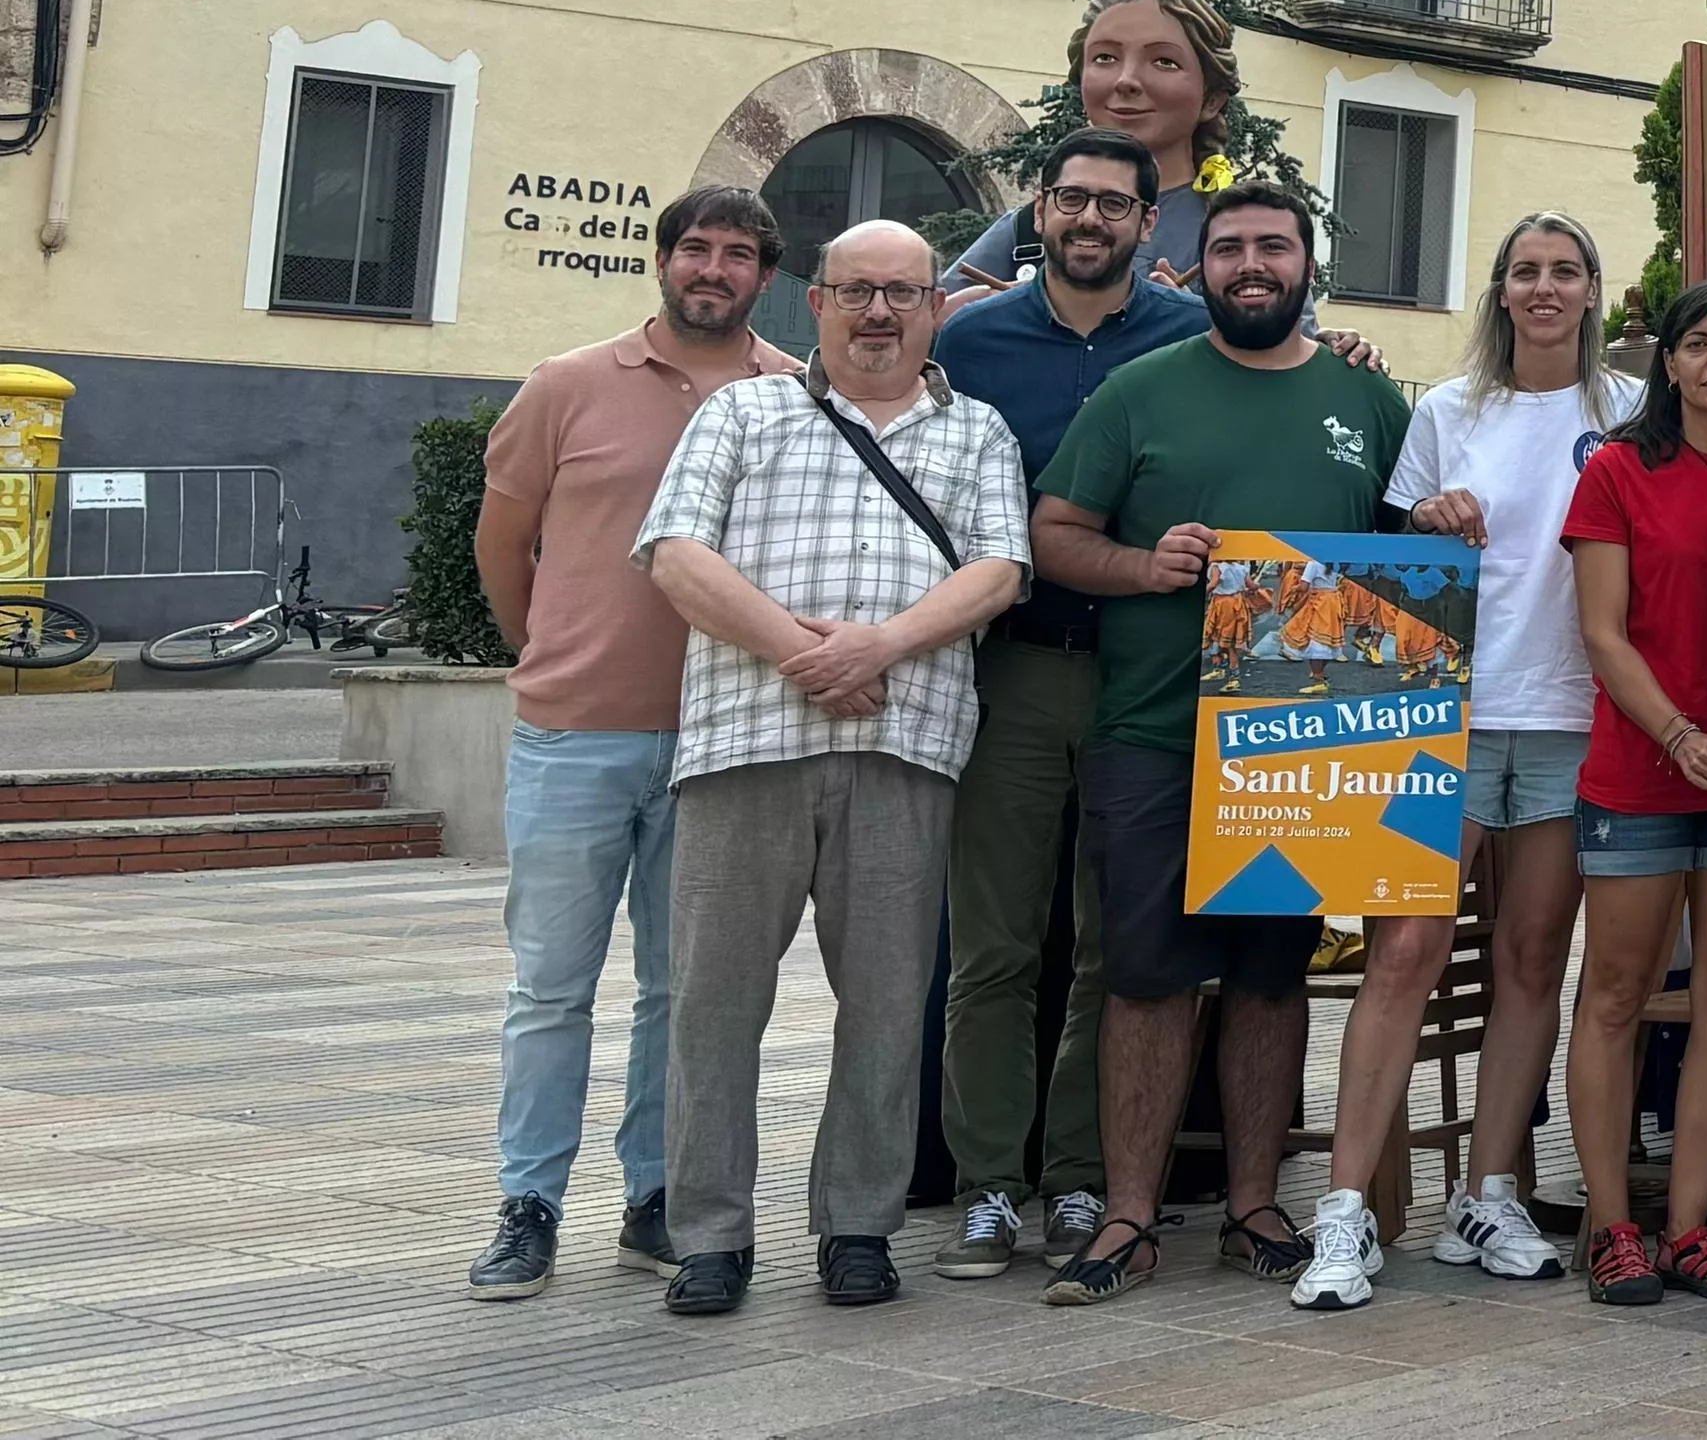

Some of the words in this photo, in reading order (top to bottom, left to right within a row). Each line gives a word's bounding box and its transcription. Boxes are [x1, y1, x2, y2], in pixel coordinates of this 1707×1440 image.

[508, 173, 651, 208] ABADIA
[579, 214, 617, 239] de
[621, 216, 649, 241] la
[1223, 710, 1327, 748] Festa
[1333, 696, 1454, 738] Major
[1219, 759, 1315, 795] Sant
[1316, 761, 1458, 802] Jaume
[1217, 805, 1312, 821] RIUDOMS
[1215, 825, 1235, 837] Del
[1239, 825, 1252, 837] 20
[1255, 825, 1267, 837] al
[1269, 826, 1284, 838] 28
[1287, 826, 1320, 838] Juliol
[1322, 826, 1351, 838] 2024
